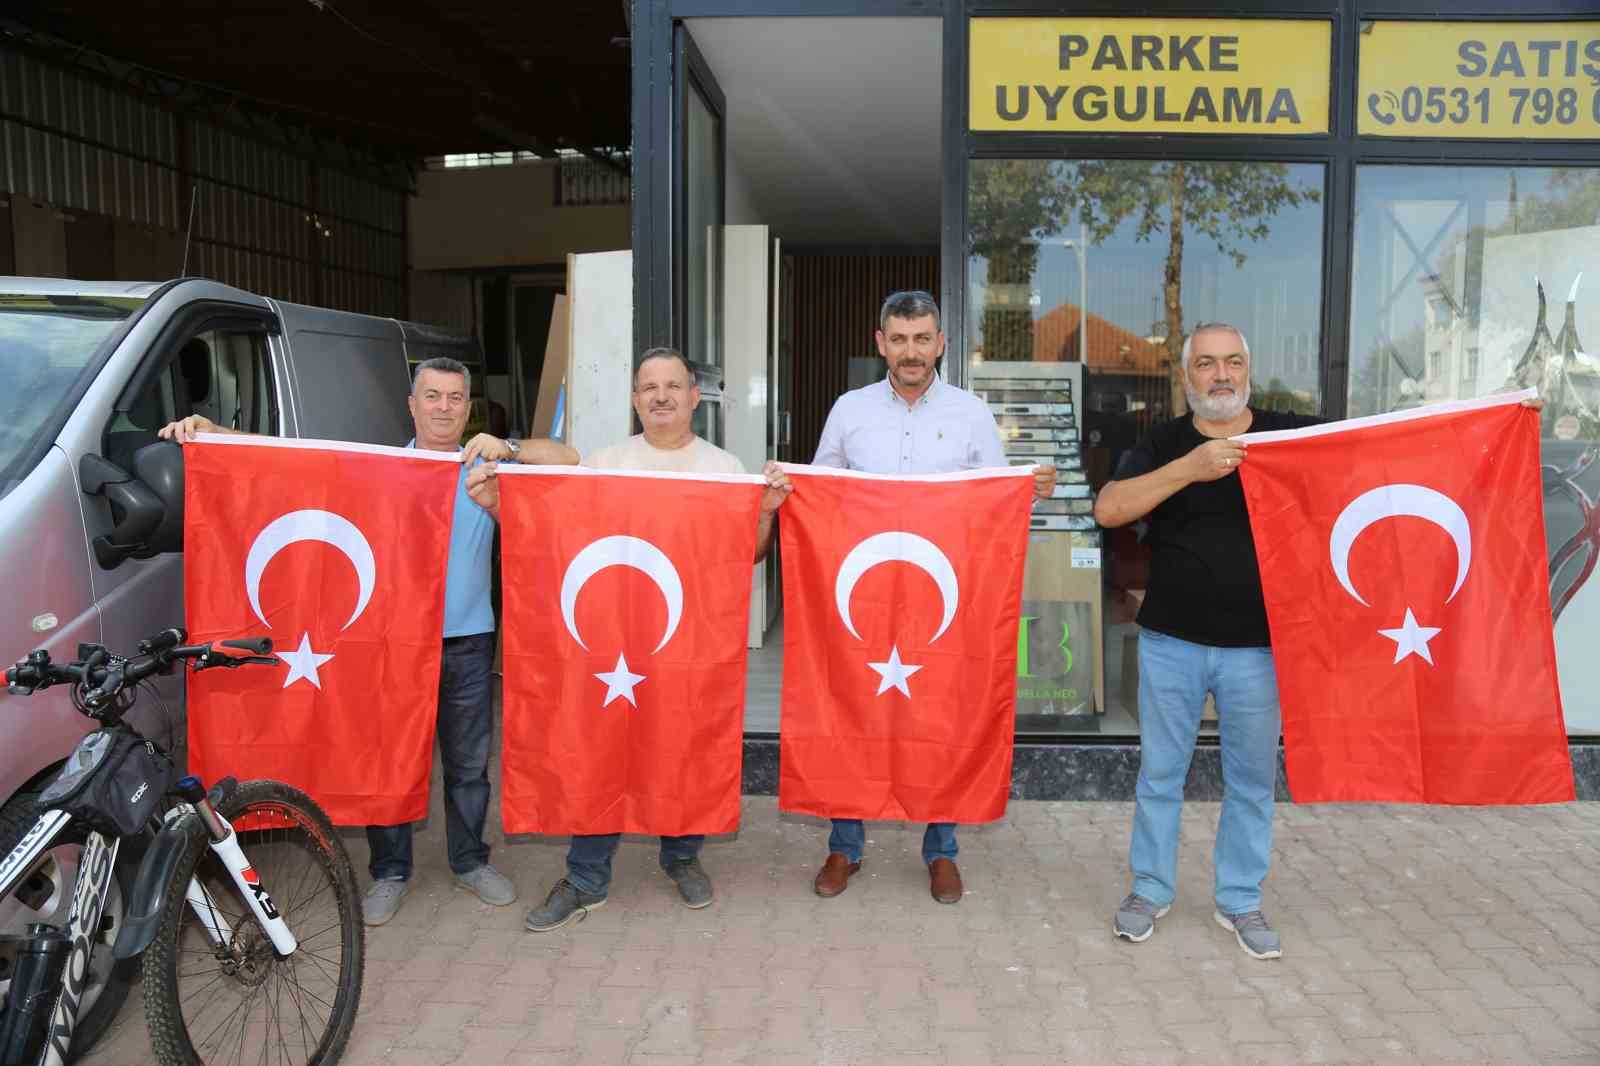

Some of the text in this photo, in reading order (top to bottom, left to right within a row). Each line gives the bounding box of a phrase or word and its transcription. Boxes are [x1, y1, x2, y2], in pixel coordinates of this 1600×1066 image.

[1057, 34, 1240, 72] PARKE
[994, 84, 1301, 125] UYGULAMA
[1401, 86, 1491, 125] 0531
[1508, 87, 1578, 125] 798
